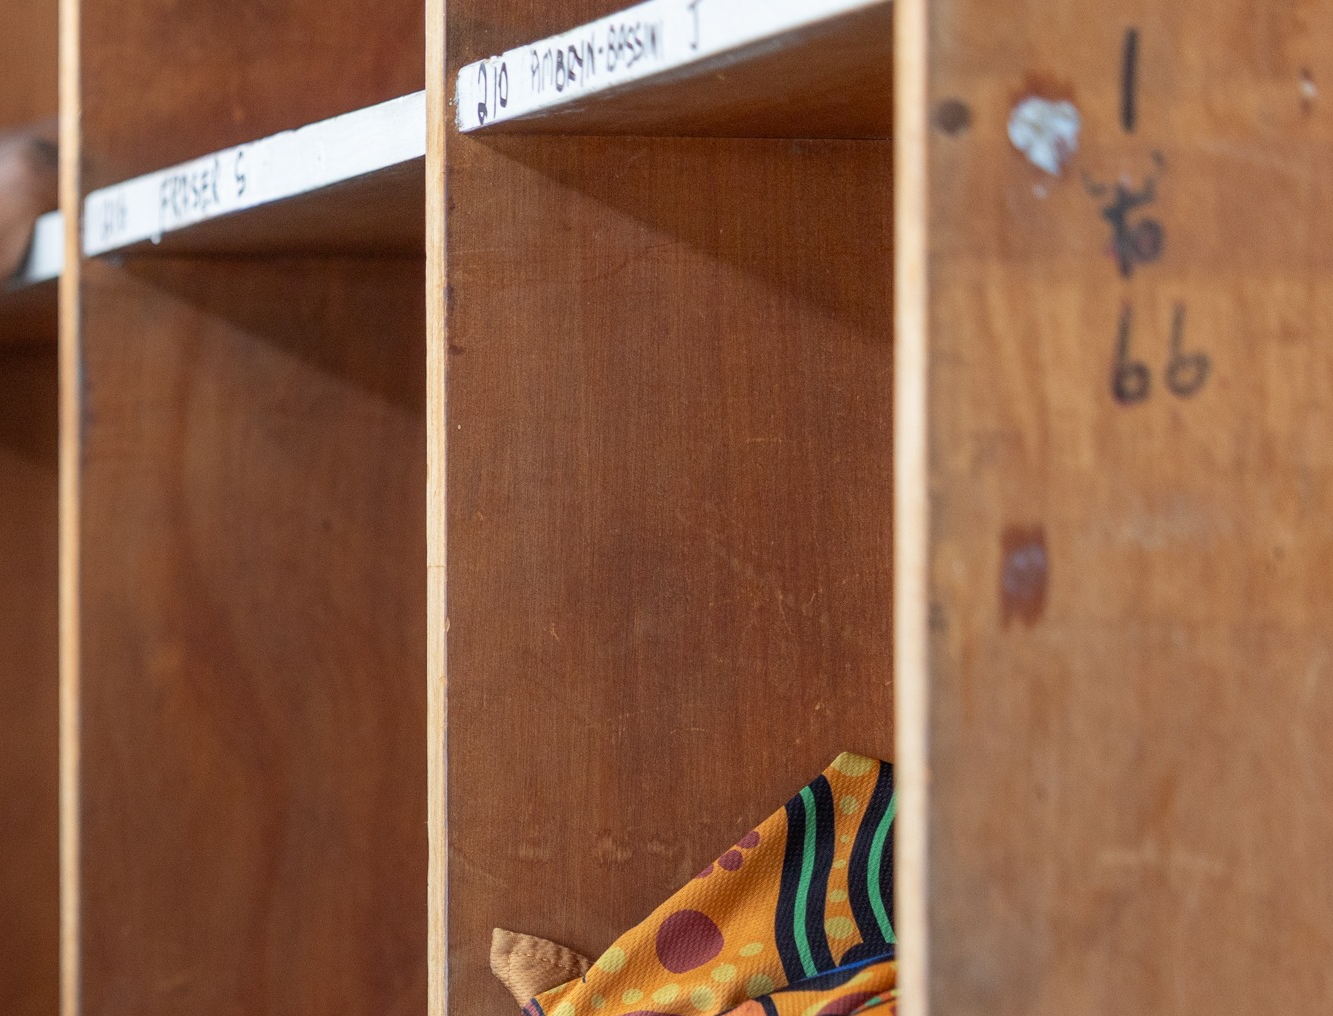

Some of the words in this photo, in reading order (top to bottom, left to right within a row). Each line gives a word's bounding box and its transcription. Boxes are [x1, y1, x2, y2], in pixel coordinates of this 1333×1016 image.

[476, 62, 509, 125] 210
[686, 1, 703, 51] J
[234, 150, 248, 198] S
